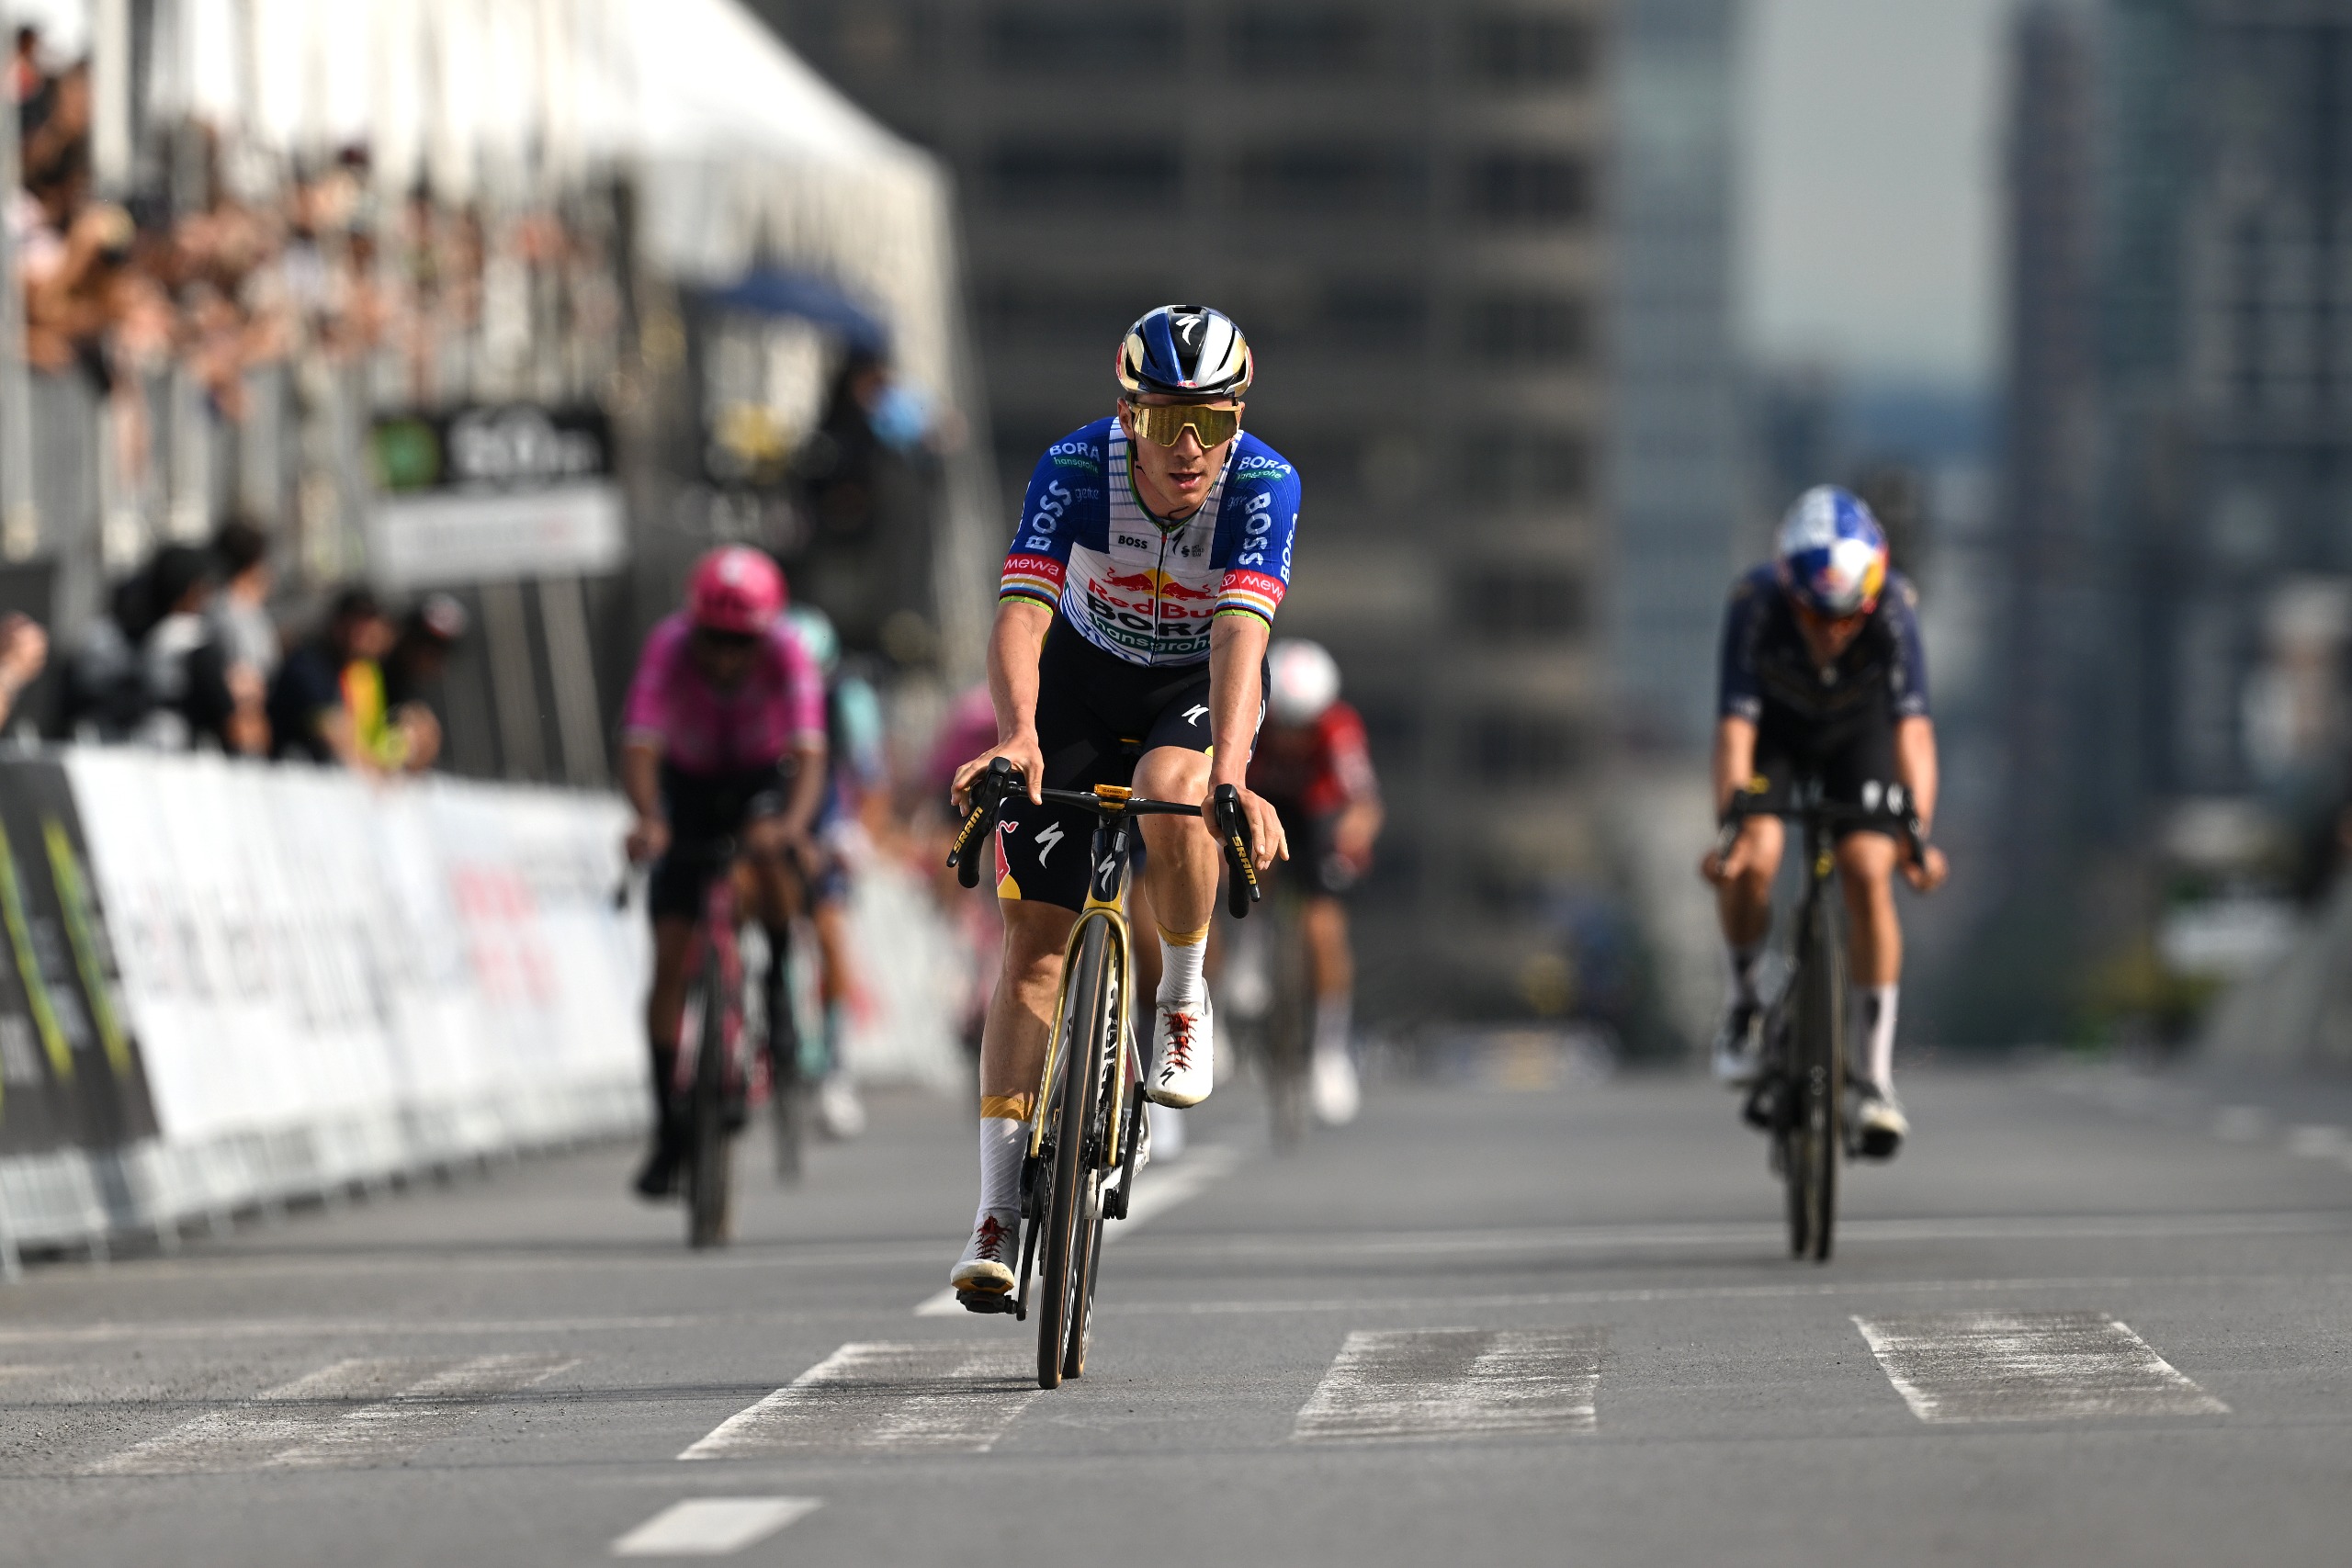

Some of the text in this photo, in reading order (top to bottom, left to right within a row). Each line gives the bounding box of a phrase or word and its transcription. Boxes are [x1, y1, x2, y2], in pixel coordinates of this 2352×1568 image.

[1049, 442, 1101, 462] BORA
[1053, 457, 1099, 474] hansgrohe
[1238, 456, 1292, 475] BORA
[1024, 479, 1073, 552] BOSS
[1238, 491, 1272, 567] BOSS
[1117, 535, 1148, 550] BOSS
[1004, 558, 1060, 576] mewa
[1087, 592, 1214, 637] BORA
[1088, 577, 1214, 619] Red Bu
[1088, 611, 1211, 652] hansgroh
[953, 806, 984, 854] SRAM
[1232, 836, 1257, 885] SRAM
